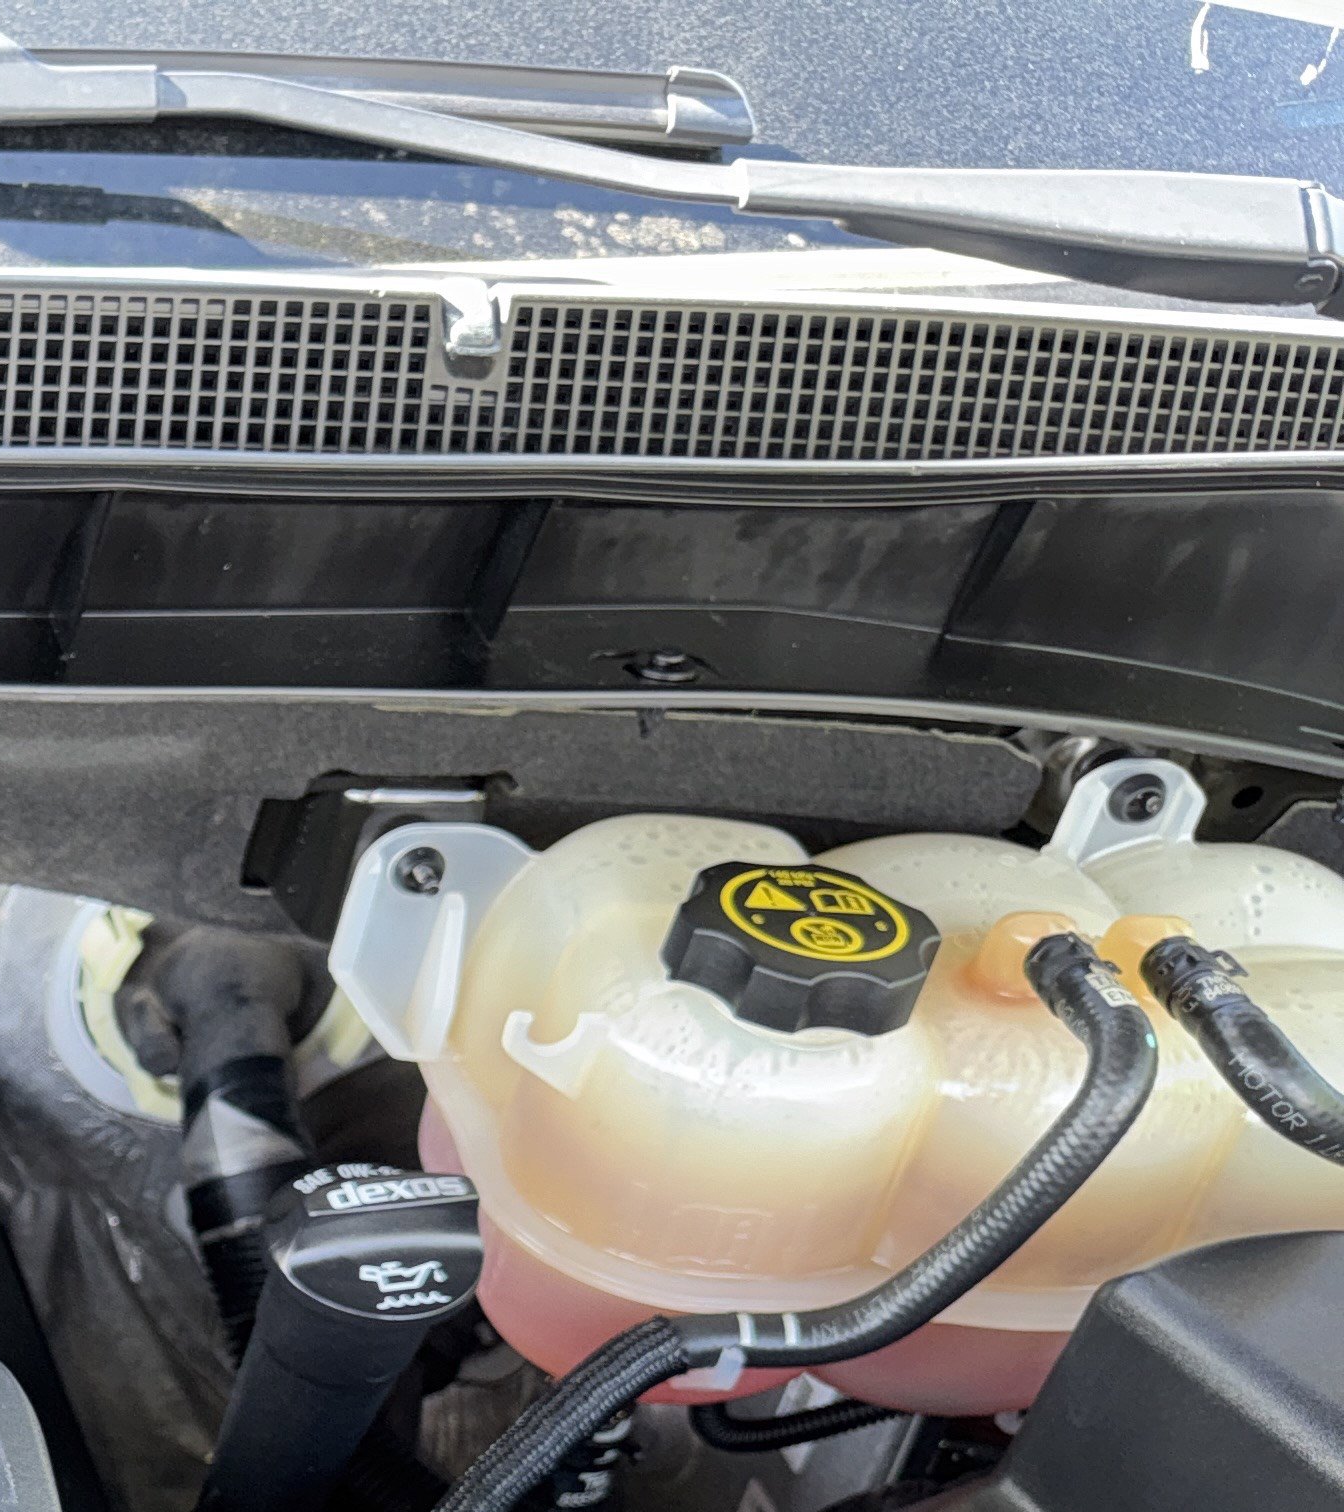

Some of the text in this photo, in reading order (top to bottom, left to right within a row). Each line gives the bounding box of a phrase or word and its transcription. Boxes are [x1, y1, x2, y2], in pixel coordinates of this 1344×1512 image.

[1227, 1051, 1308, 1131] MOTOR
[293, 1168, 336, 1194] SAE
[326, 1176, 469, 1211] dexos
